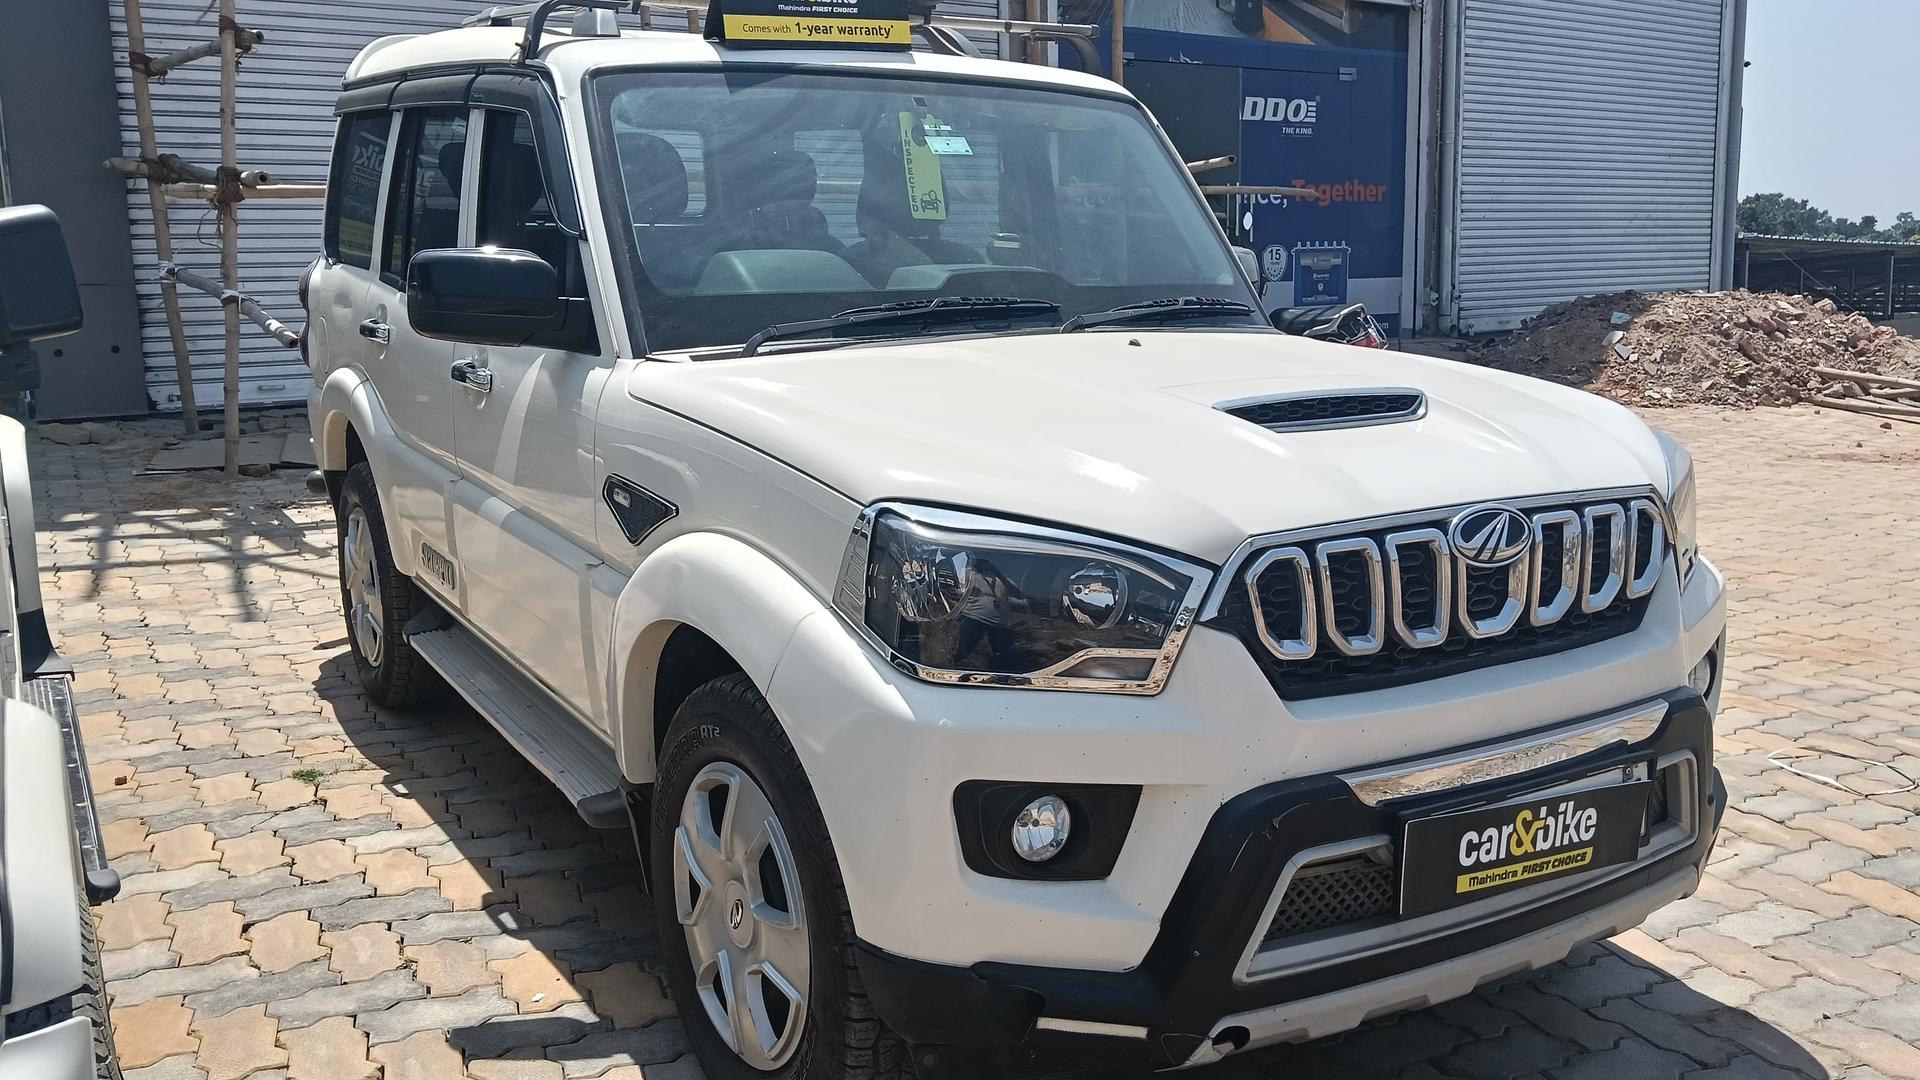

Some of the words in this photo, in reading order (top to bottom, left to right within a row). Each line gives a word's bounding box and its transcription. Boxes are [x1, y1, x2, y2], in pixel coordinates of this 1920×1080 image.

[778, 4, 811, 12] Mahindra
[742, 23, 773, 34] Comes
[774, 25, 791, 34] with
[795, 22, 834, 37] 1-year
[904, 129, 919, 213] INSPECTED
[1291, 179, 1387, 207] Together
[1268, 248, 1281, 261] 15
[1458, 800, 1598, 867] car&bike
[1468, 868, 1518, 888] Mahindra
[1521, 860, 1551, 876] FIRST
[1551, 851, 1588, 869] CHOICE
